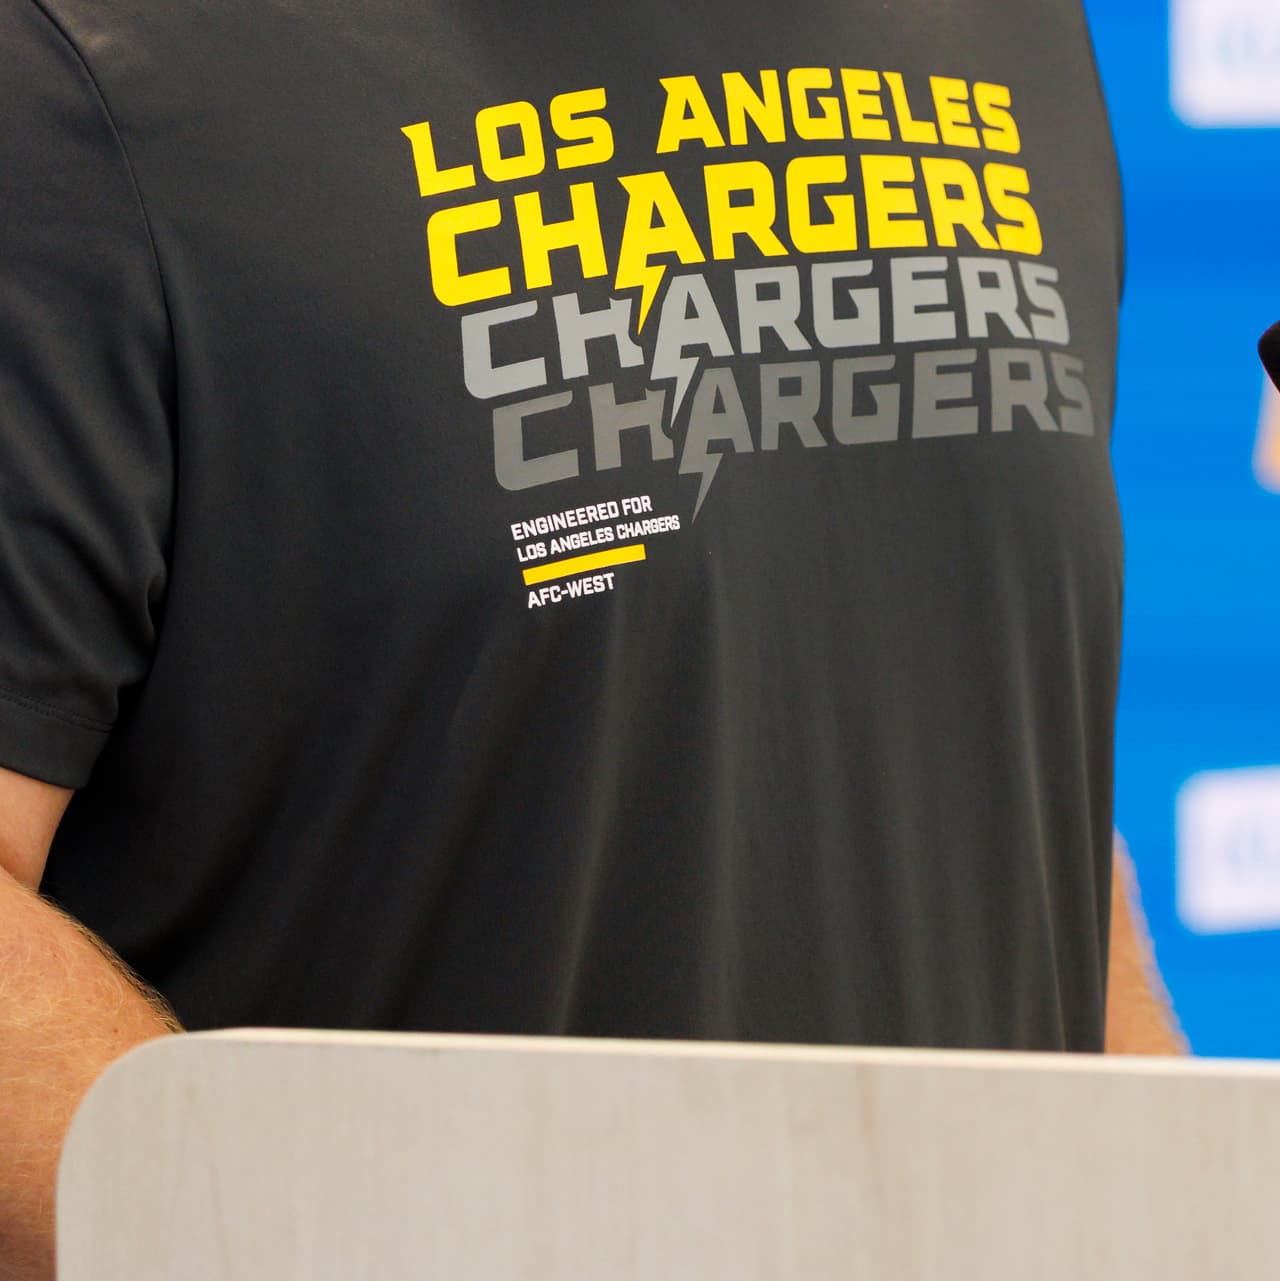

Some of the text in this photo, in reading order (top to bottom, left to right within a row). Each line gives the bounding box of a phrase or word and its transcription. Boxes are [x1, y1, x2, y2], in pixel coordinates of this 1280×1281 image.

[400, 67, 1022, 198] LOS ANGELES
[426, 154, 1044, 333] CHARGERS
[460, 255, 1073, 428] CHARGERS
[492, 348, 1097, 522] CHARGERS
[510, 495, 654, 541] ENGINEERED FOR
[516, 514, 681, 563] LOS ANGELES CHARGERS
[527, 572, 616, 609] AFC-WEST
